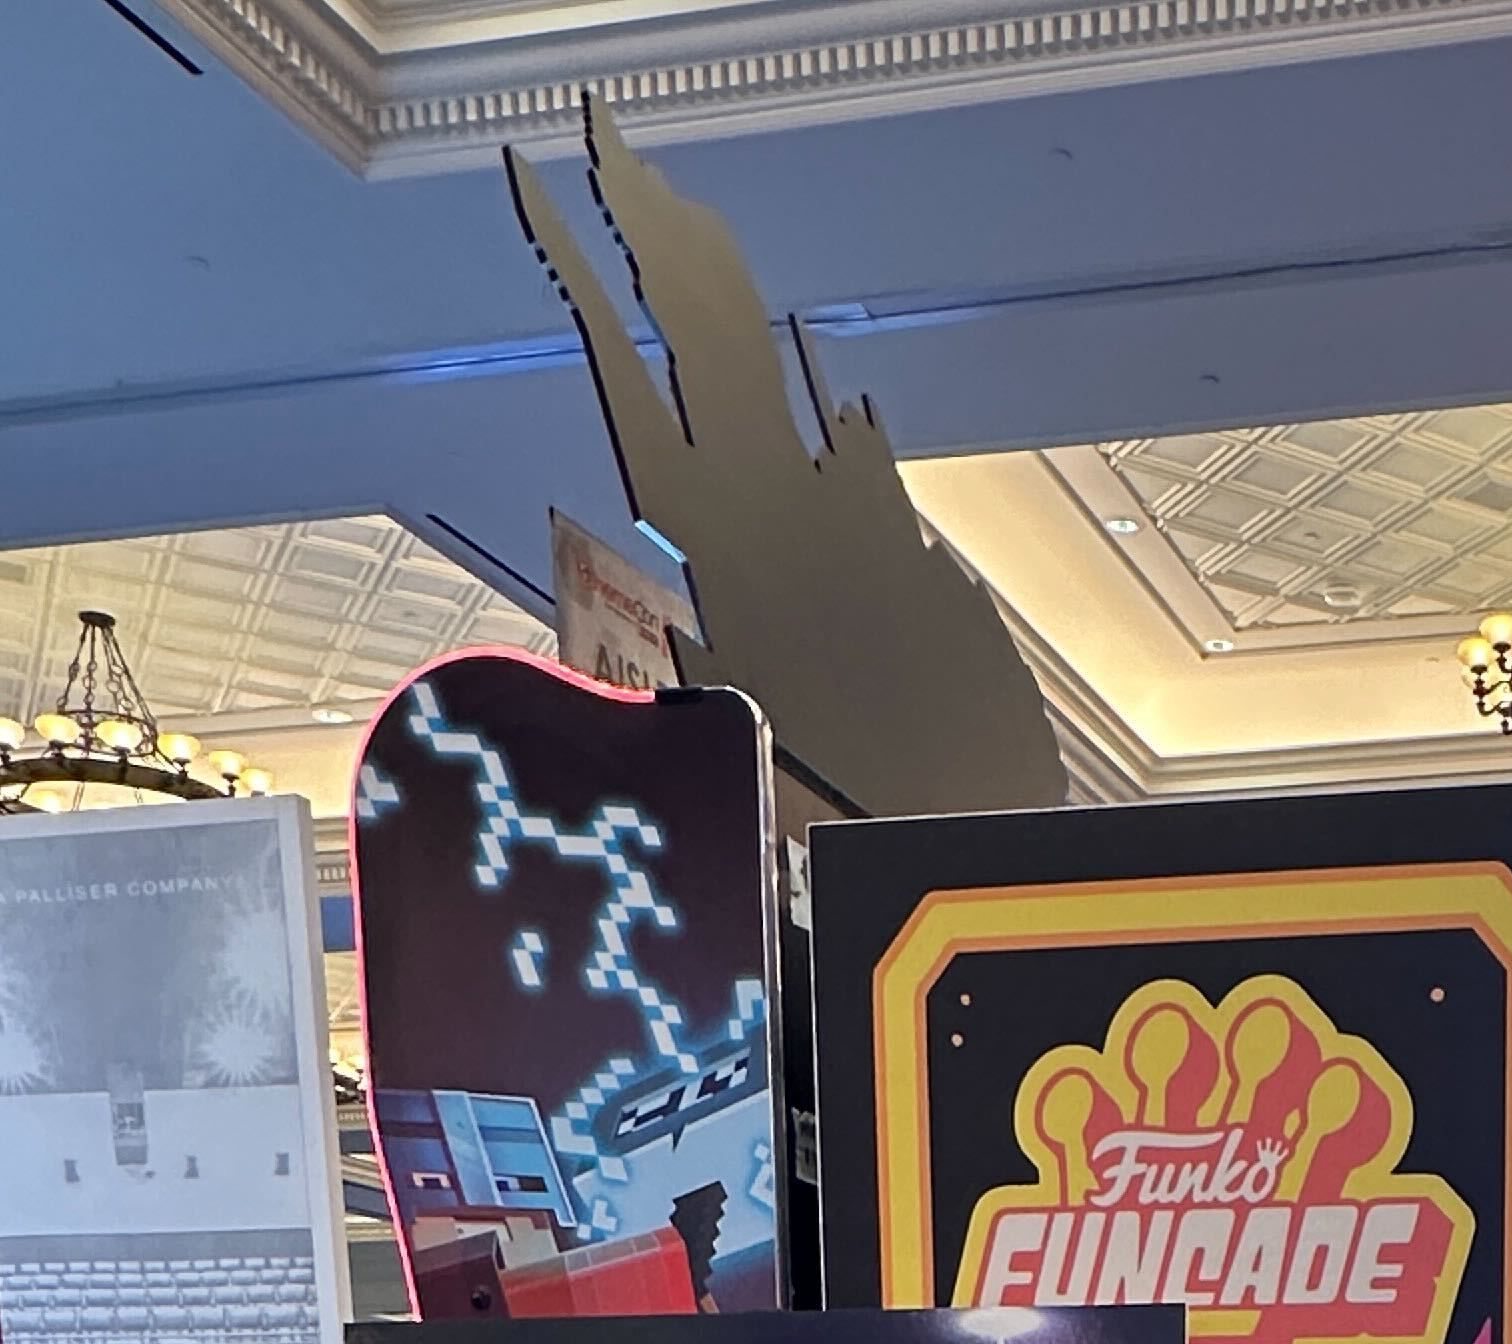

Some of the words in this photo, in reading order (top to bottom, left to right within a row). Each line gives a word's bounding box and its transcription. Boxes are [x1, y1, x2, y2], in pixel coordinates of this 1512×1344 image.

[15, 882, 118, 904] PALLISER
[127, 874, 232, 897] COMPANY
[1091, 1129, 1290, 1207] Funko
[978, 1203, 1420, 1308] FUNCADE
